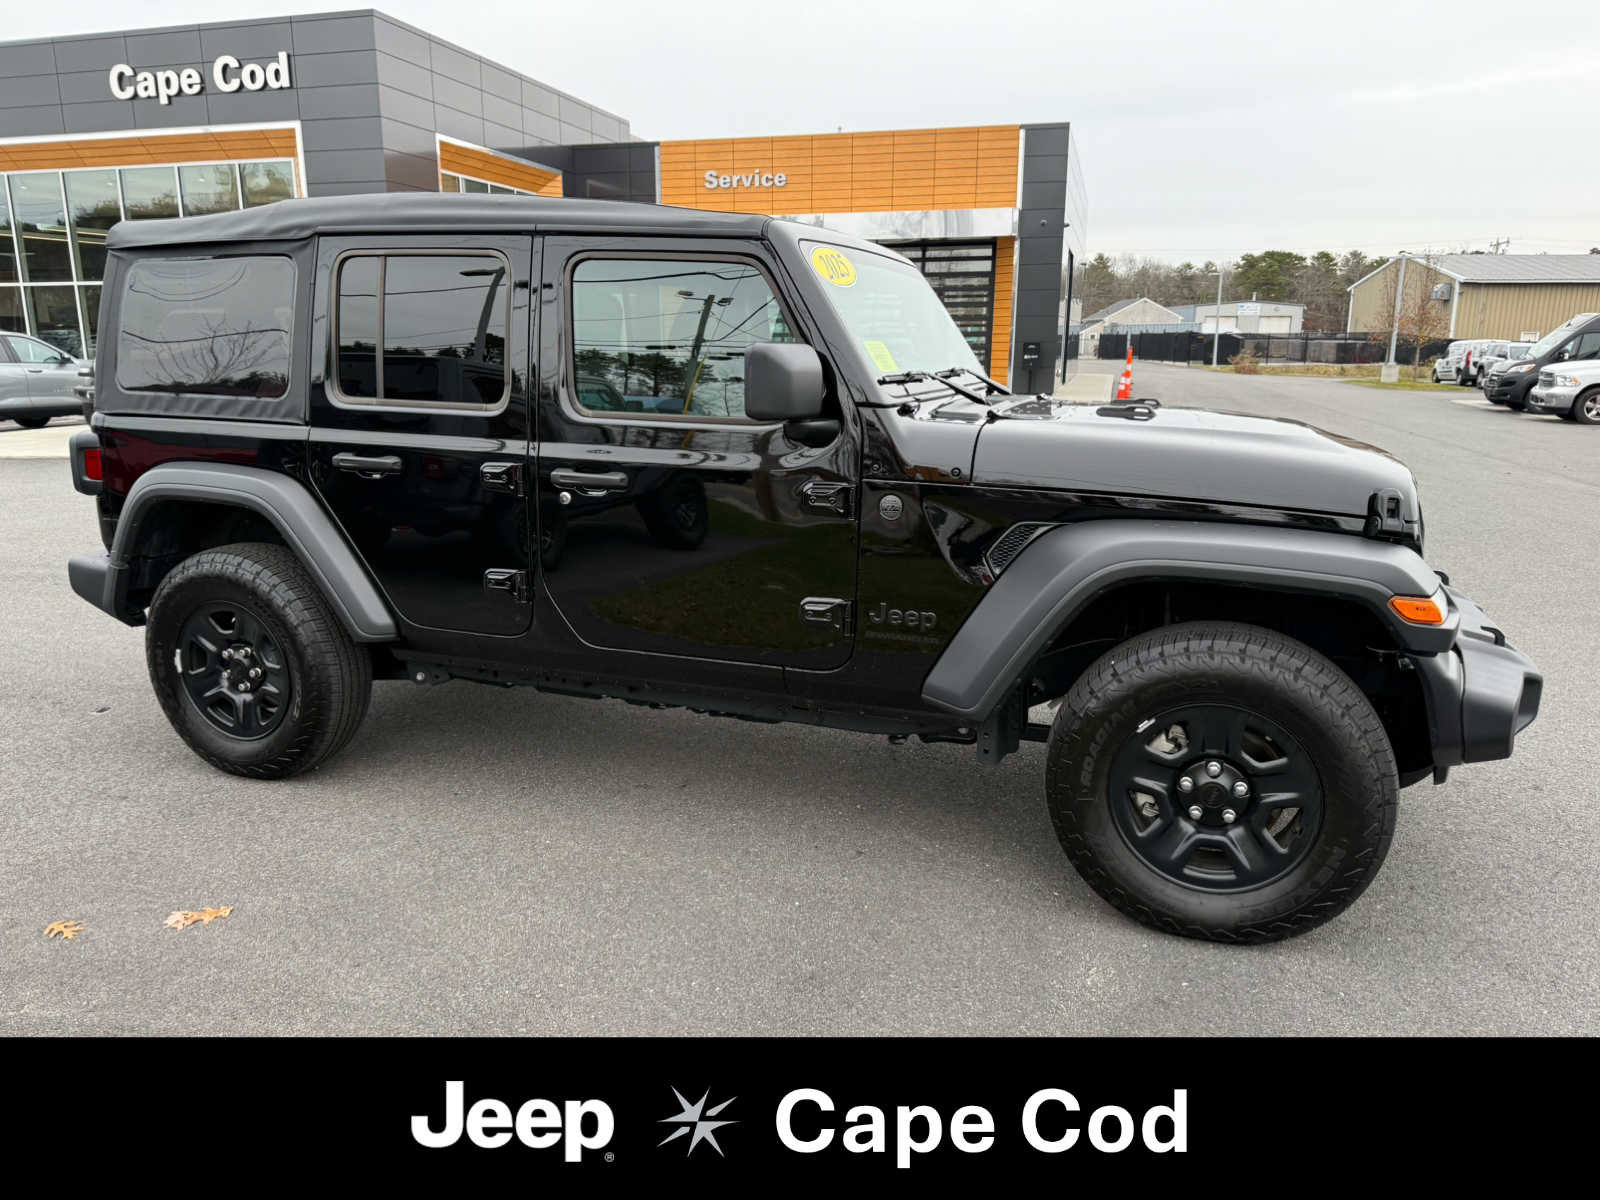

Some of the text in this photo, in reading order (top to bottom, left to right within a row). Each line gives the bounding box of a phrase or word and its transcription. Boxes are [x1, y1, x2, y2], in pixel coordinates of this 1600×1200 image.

[109, 51, 291, 105] Cape Cod
[704, 168, 787, 189] Service
[869, 602, 937, 631] Jeep
